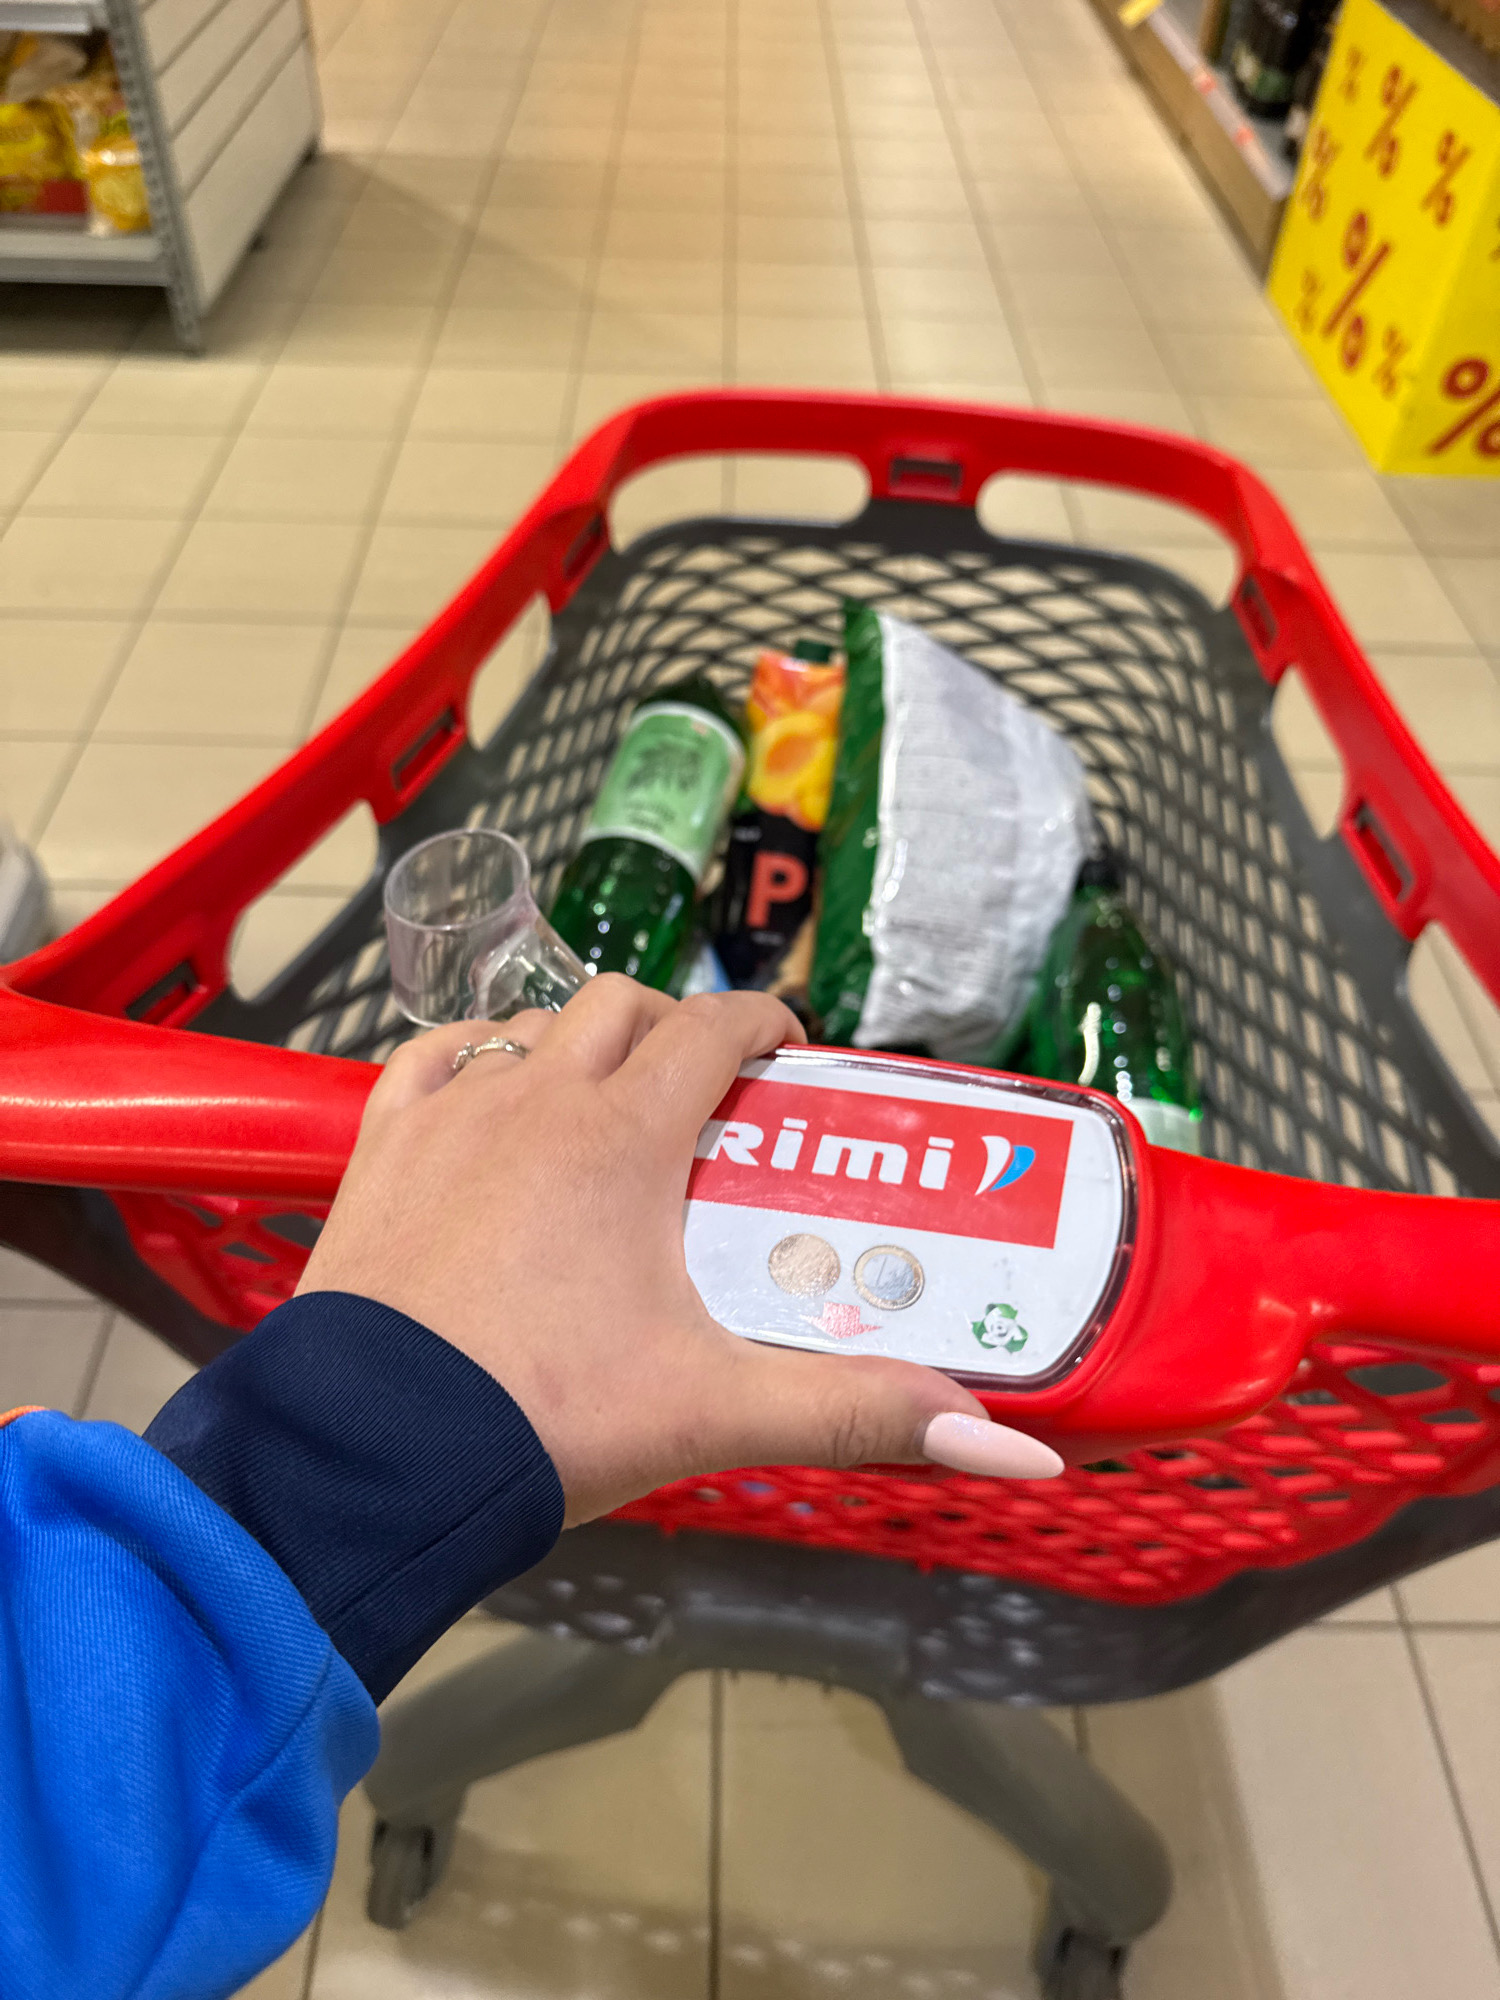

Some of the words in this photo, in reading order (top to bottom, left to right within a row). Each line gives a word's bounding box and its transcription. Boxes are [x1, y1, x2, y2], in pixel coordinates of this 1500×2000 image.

[1363, 64, 1419, 177] %
[1419, 129, 1472, 227] %
[1322, 210, 1393, 374] %
[1427, 357, 1500, 459] %
[747, 851, 808, 928] P
